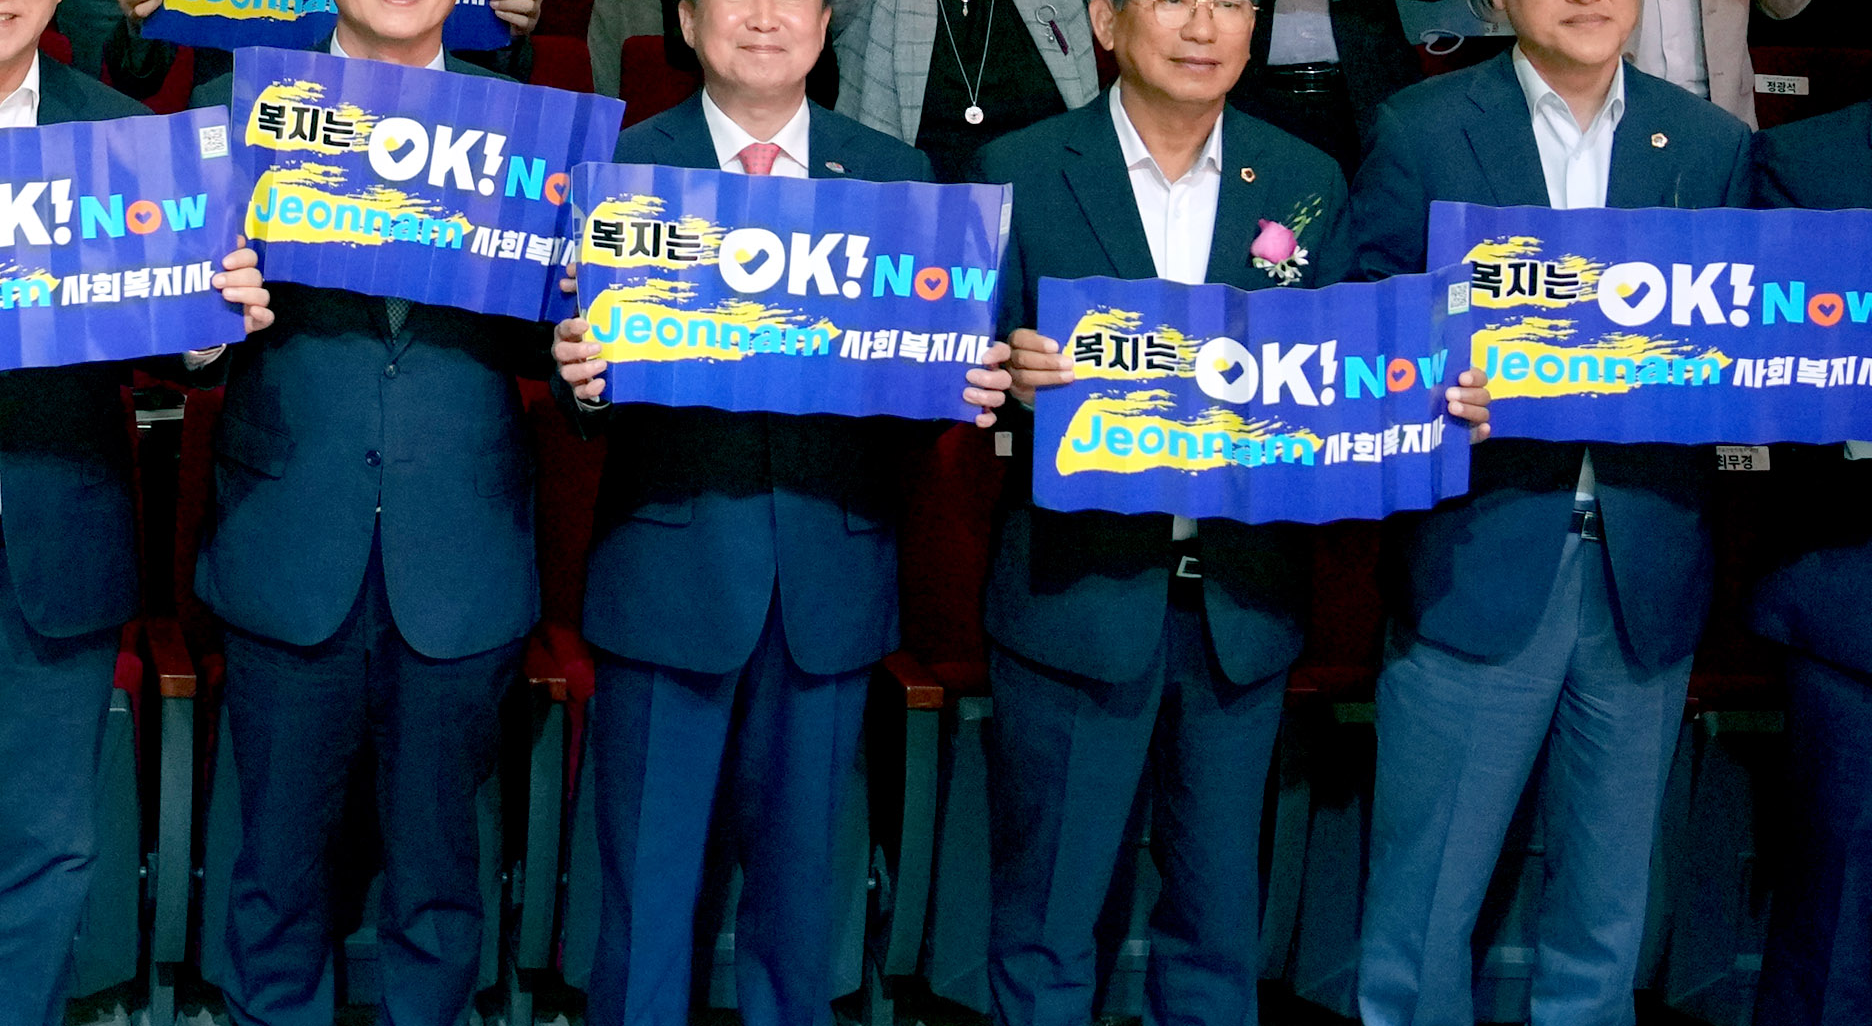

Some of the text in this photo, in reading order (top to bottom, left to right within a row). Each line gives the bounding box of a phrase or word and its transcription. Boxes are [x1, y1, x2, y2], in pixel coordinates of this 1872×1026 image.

[257, 101, 572, 206] 복지는 OK! No
[255, 186, 465, 250] Jeonnam
[61, 261, 215, 306] 사회복지사
[591, 219, 701, 262] 복지는
[719, 227, 870, 298] OK!
[1472, 260, 1580, 301] 복지는
[1597, 261, 1755, 327] OK!
[592, 306, 991, 365] Jeonnam 사회복지사
[1485, 346, 1721, 387] Jeonnam
[1074, 334, 1179, 373] 복지는
[1195, 336, 1339, 406] OK!
[1072, 414, 1445, 467] Jeonnam 사회복지사
